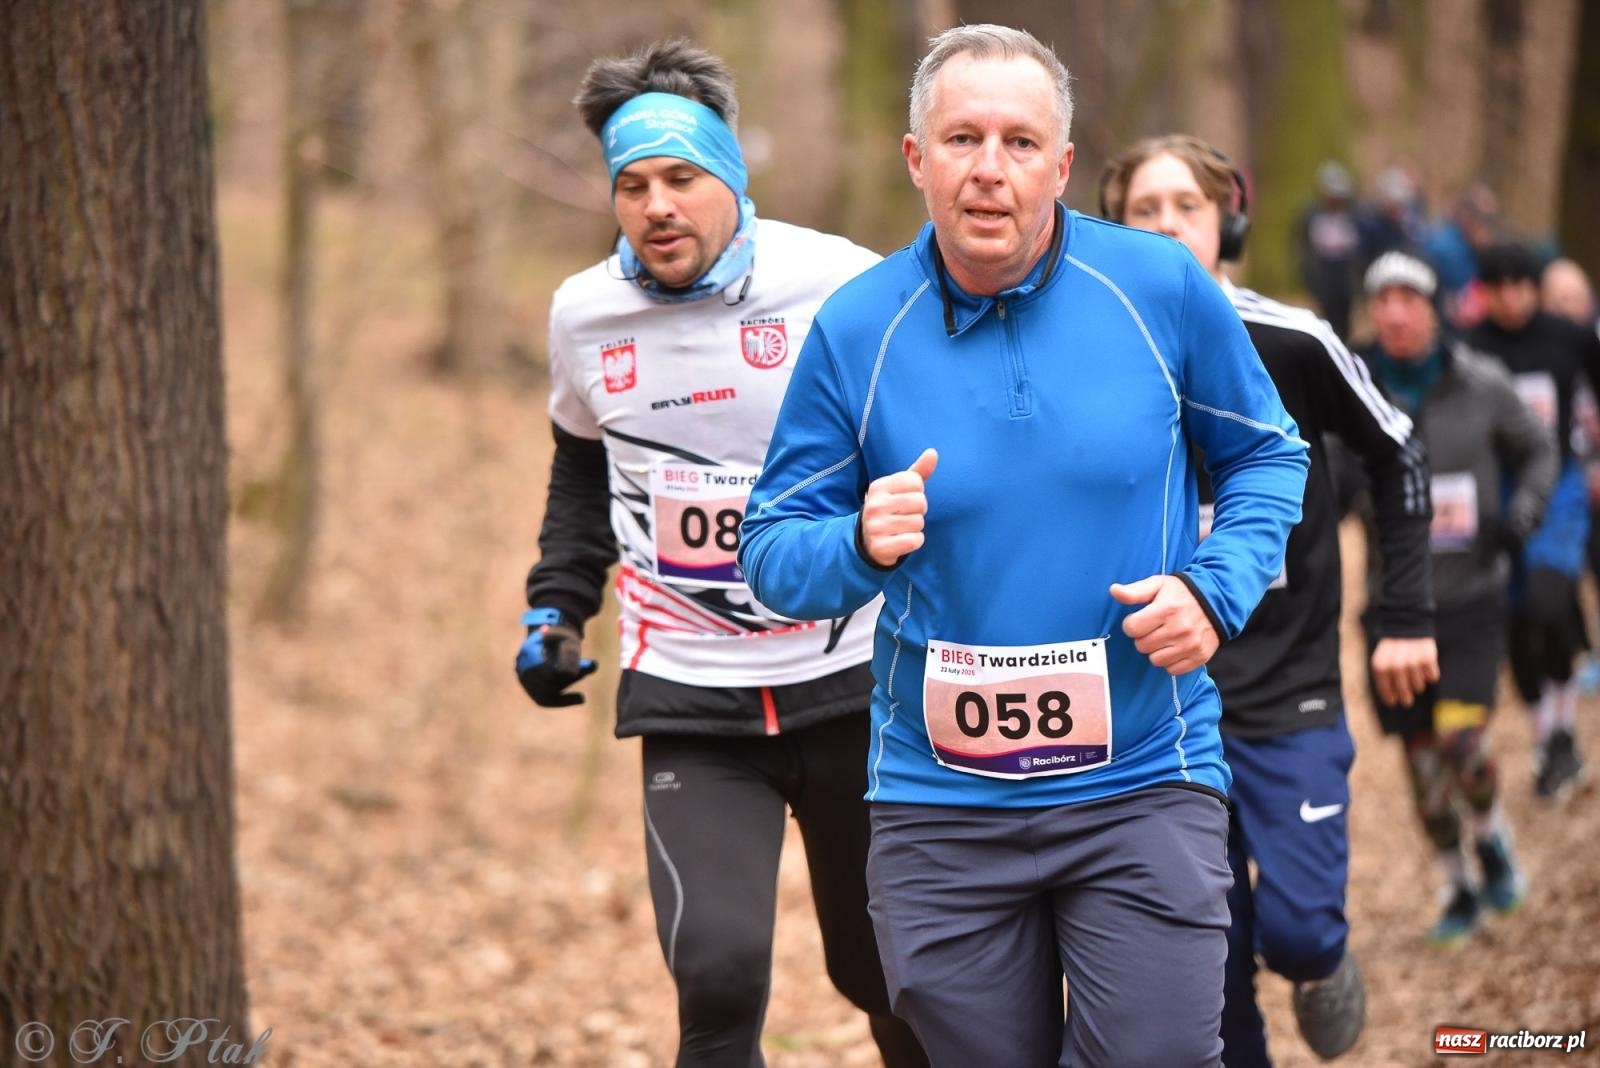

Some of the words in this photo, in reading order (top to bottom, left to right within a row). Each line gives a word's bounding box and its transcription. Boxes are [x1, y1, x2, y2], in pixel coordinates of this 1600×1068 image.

[665, 469, 699, 484] BIEG
[941, 649, 974, 666] BIEG
[978, 649, 1088, 668] Twardziela
[948, 667, 961, 676] luty
[961, 668, 976, 676] 2025
[955, 690, 1074, 740] 058
[1032, 754, 1077, 766] Racibórz
